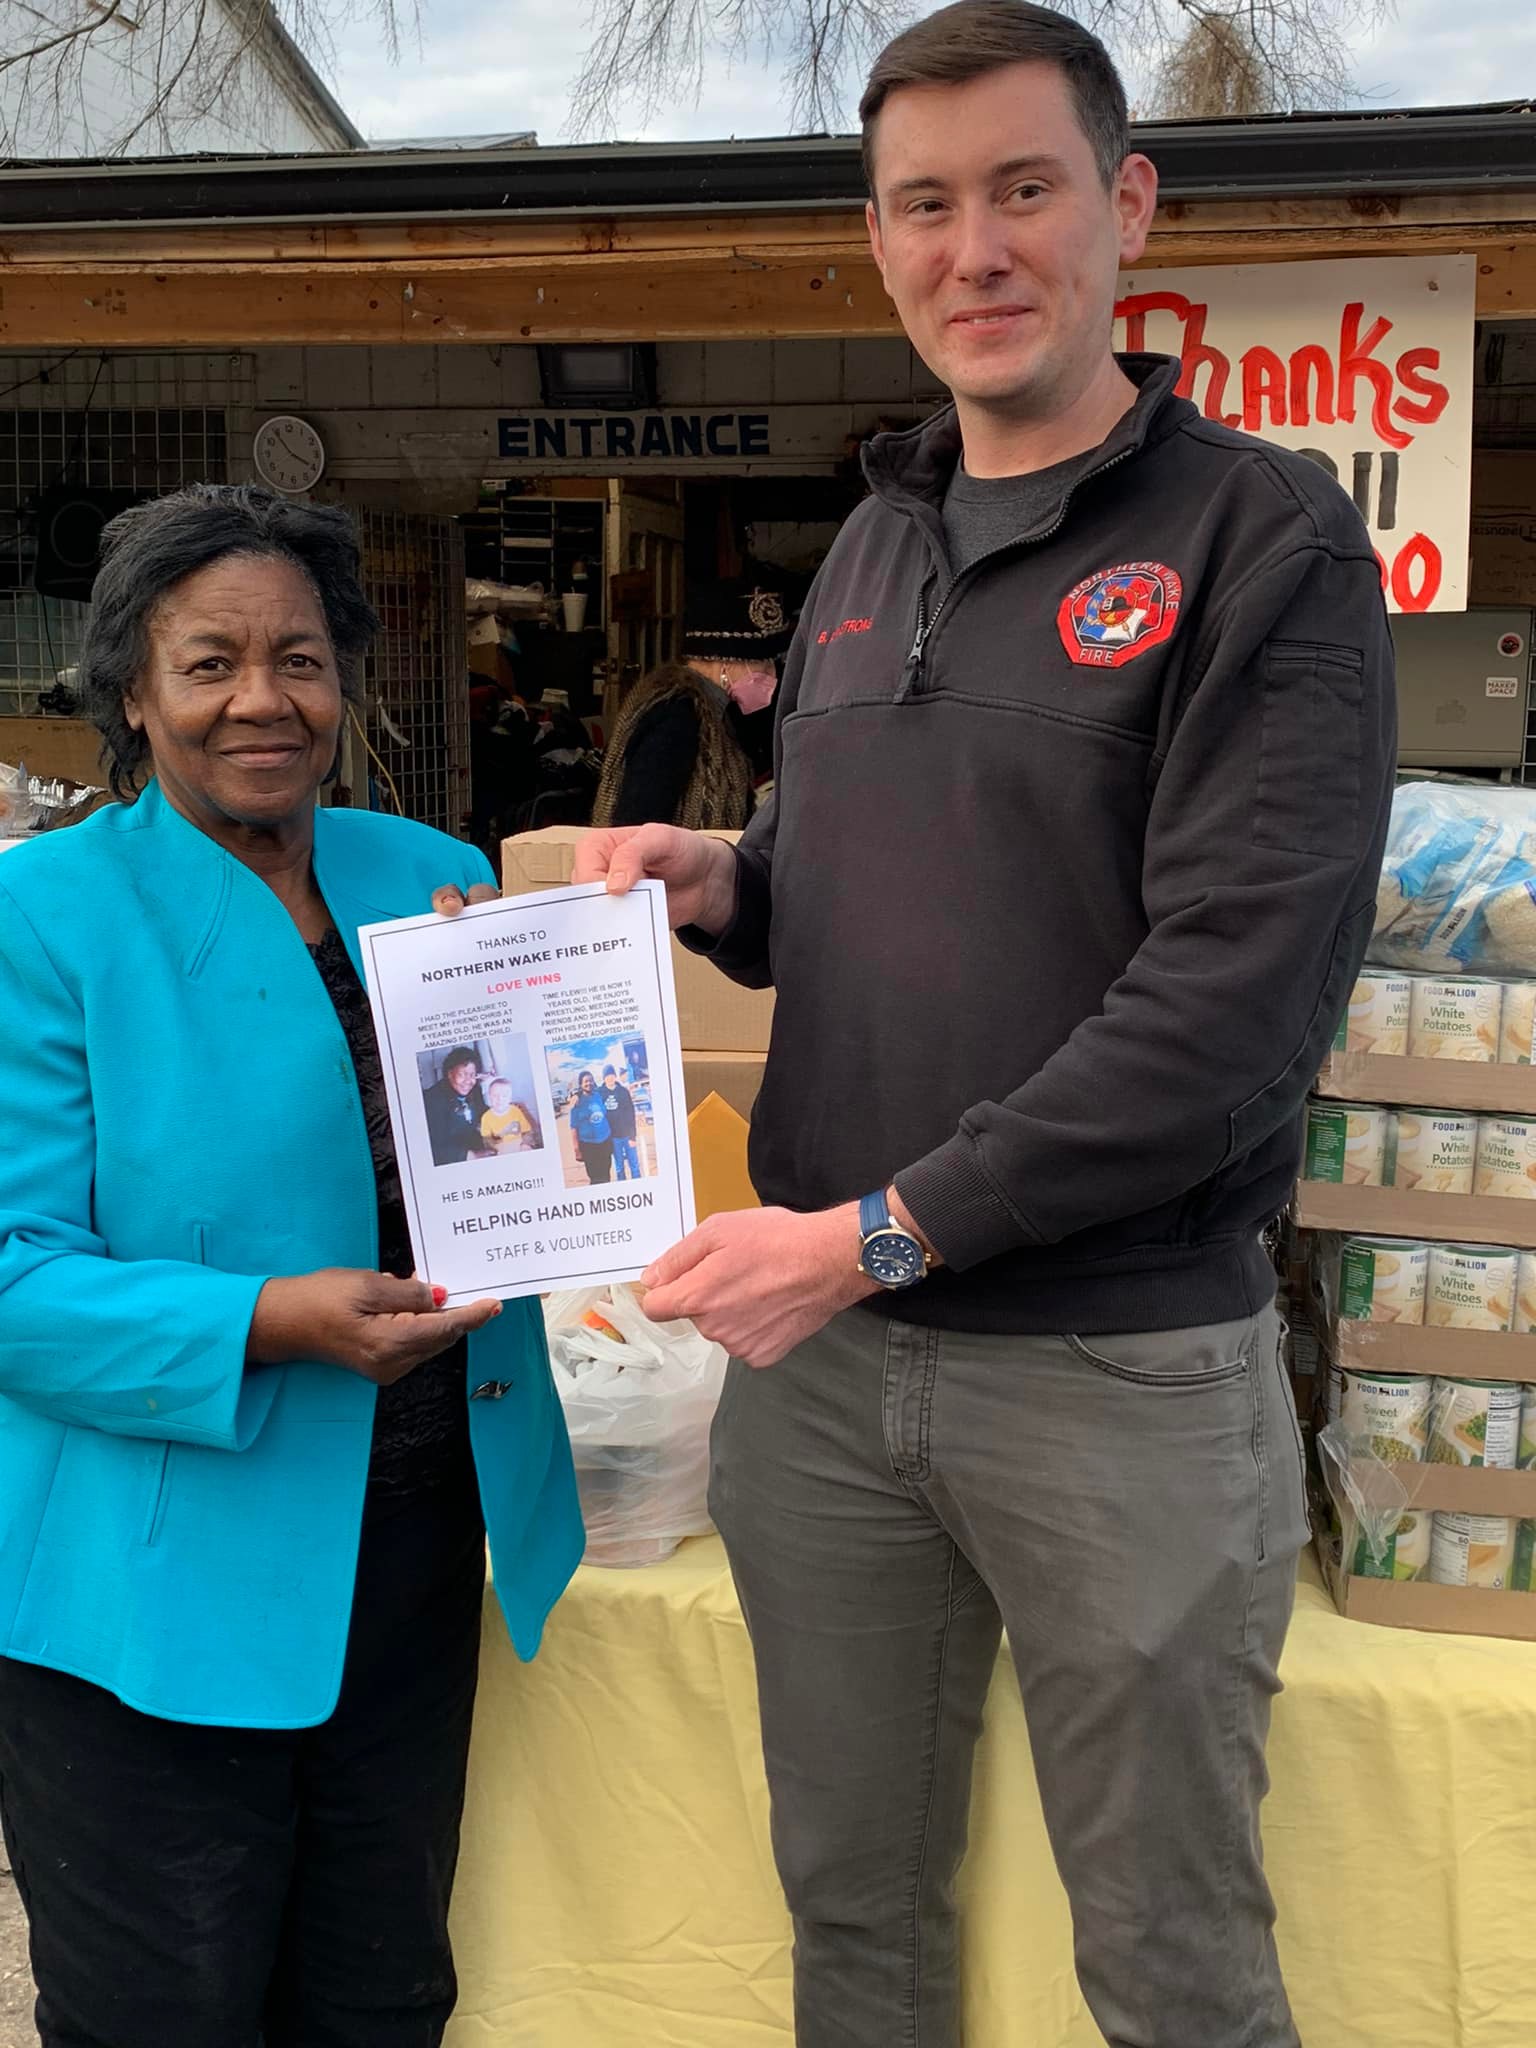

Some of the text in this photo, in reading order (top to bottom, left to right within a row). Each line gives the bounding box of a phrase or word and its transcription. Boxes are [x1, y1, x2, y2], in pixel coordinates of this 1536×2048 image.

[497, 414, 770, 457] ENTRANCE
[1068, 561, 1180, 610] NORTHERN WAKE
[1079, 648, 1115, 664] FIRE
[476, 930, 547, 951] THANKS TO
[421, 938, 632, 983] NORTHERN WAKE FIRE DEPT.
[487, 972, 561, 995] LOVE WINS
[541, 992, 559, 1001] TIME
[588, 985, 598, 993] HE
[599, 984, 607, 992] IS
[607, 981, 623, 990] NOW
[1424, 986, 1477, 998] FOOD LION
[547, 998, 572, 1008] YEARS
[603, 990, 630, 1000] ENJOYS
[588, 1000, 618, 1010] MEETING
[620, 998, 635, 1006] NEW
[418, 1008, 513, 1032] MEET MY FRIEND CHRIS AT
[424, 1014, 441, 1023] HAD
[442, 1010, 457, 1019] THE
[458, 1003, 496, 1017] PLEASURE
[497, 1000, 508, 1008] TO
[541, 1005, 640, 1027] FRIENDS AND SPENDING TIME
[1430, 1006, 1465, 1020] White
[427, 1030, 452, 1040] YEARS
[472, 1023, 482, 1031] HE
[483, 1019, 501, 1029] WAS
[545, 1014, 639, 1035] WITH HIS FOSTER MOM WHO
[1423, 1018, 1472, 1032] Potatoes
[424, 1036, 457, 1049] AMAZING
[459, 1031, 488, 1042] FOSTER
[551, 1035, 567, 1043] HAS
[568, 1032, 588, 1040] SINCE
[590, 1026, 623, 1037] ADOPTED
[1432, 1121, 1454, 1131] FOOD
[1507, 1126, 1527, 1136] LION
[1441, 1141, 1471, 1153] White
[1485, 1143, 1515, 1157] White
[442, 1177, 545, 1203] HE IS AMAZING!!!
[453, 1191, 653, 1236] HELPING HAND MISSION
[486, 1228, 633, 1262] STAFF & VOLUNTEERS
[1435, 1256, 1487, 1271] FOOD LION
[1441, 1275, 1475, 1292] White
[1434, 1286, 1482, 1304] Potatoes
[1357, 1383, 1410, 1397] FOOD LION
[1363, 1403, 1398, 1417] Sweet
